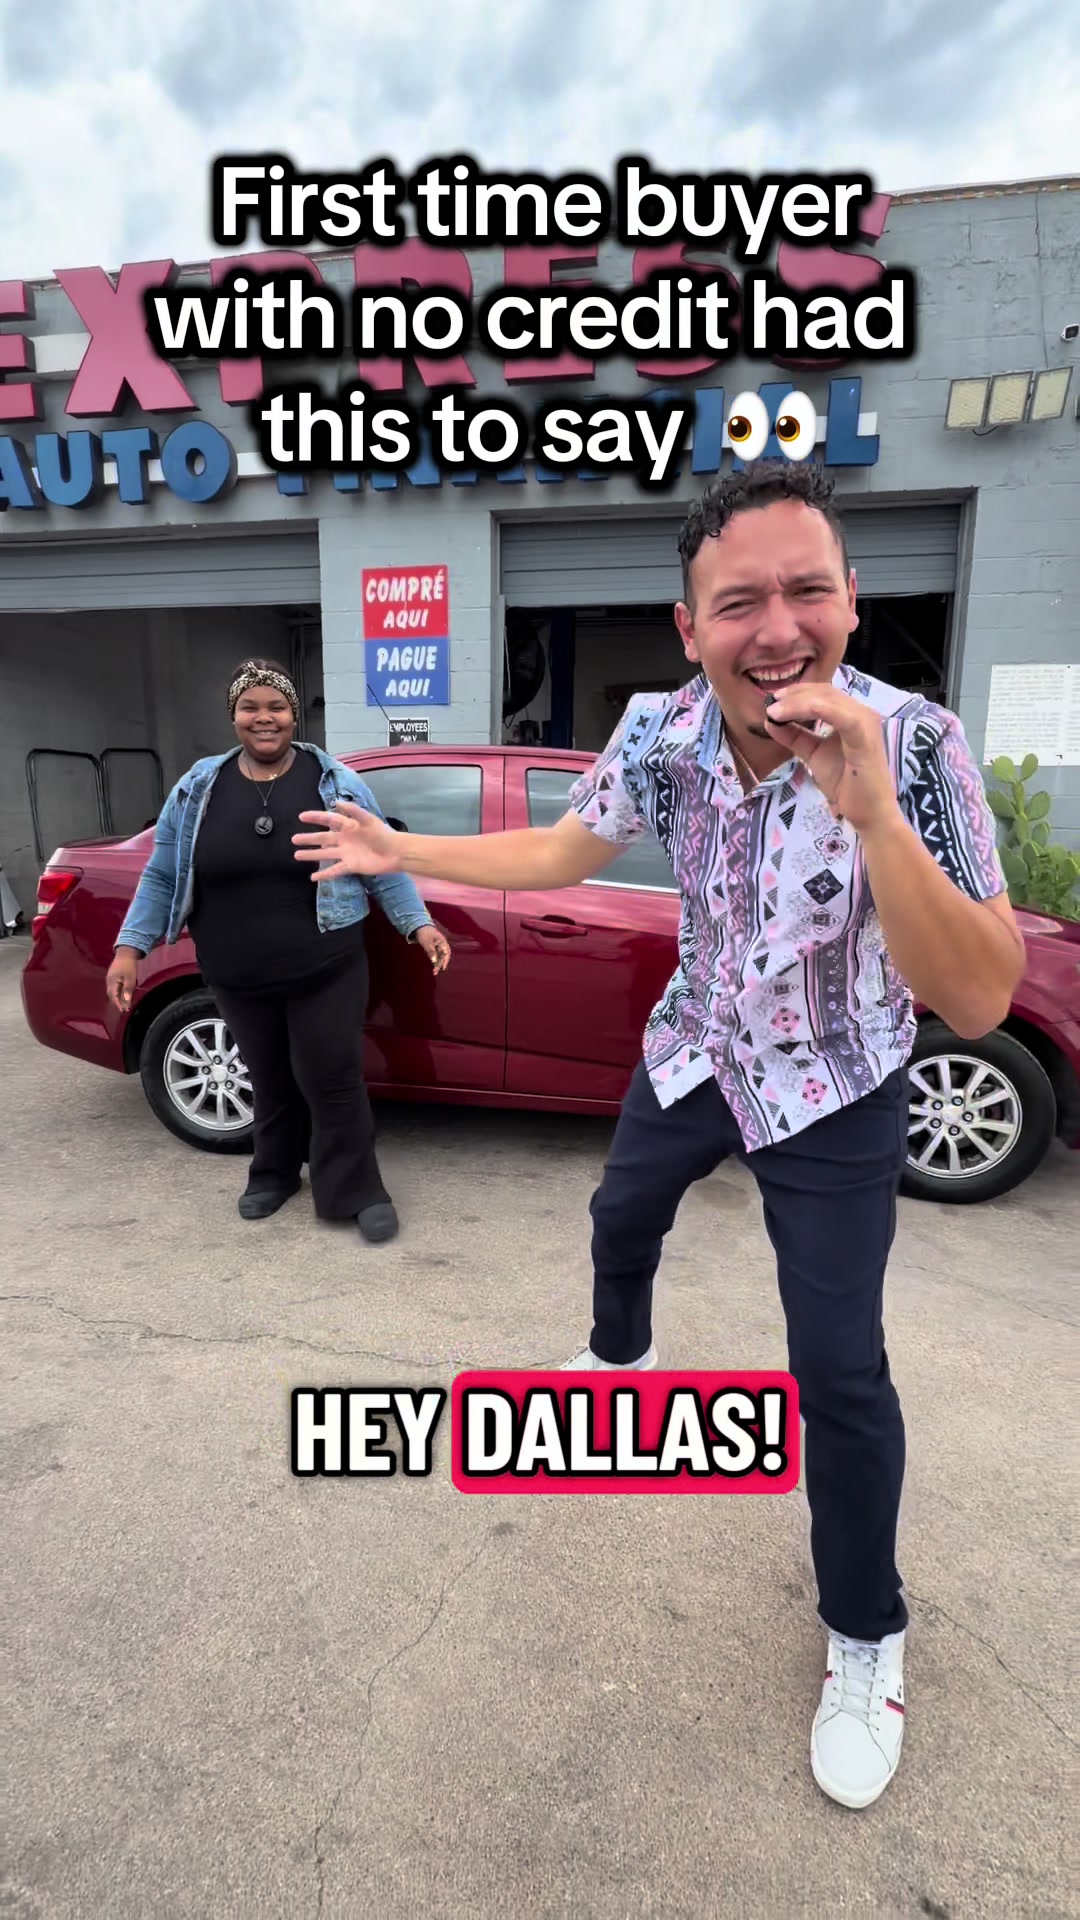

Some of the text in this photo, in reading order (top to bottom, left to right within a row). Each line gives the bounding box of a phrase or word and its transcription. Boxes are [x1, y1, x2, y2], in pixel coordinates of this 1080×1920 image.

[365, 568, 446, 604] COMPRÉ
[383, 609, 429, 629] AQUI
[376, 645, 438, 672] PAGUE
[385, 678, 431, 698] AQUI
